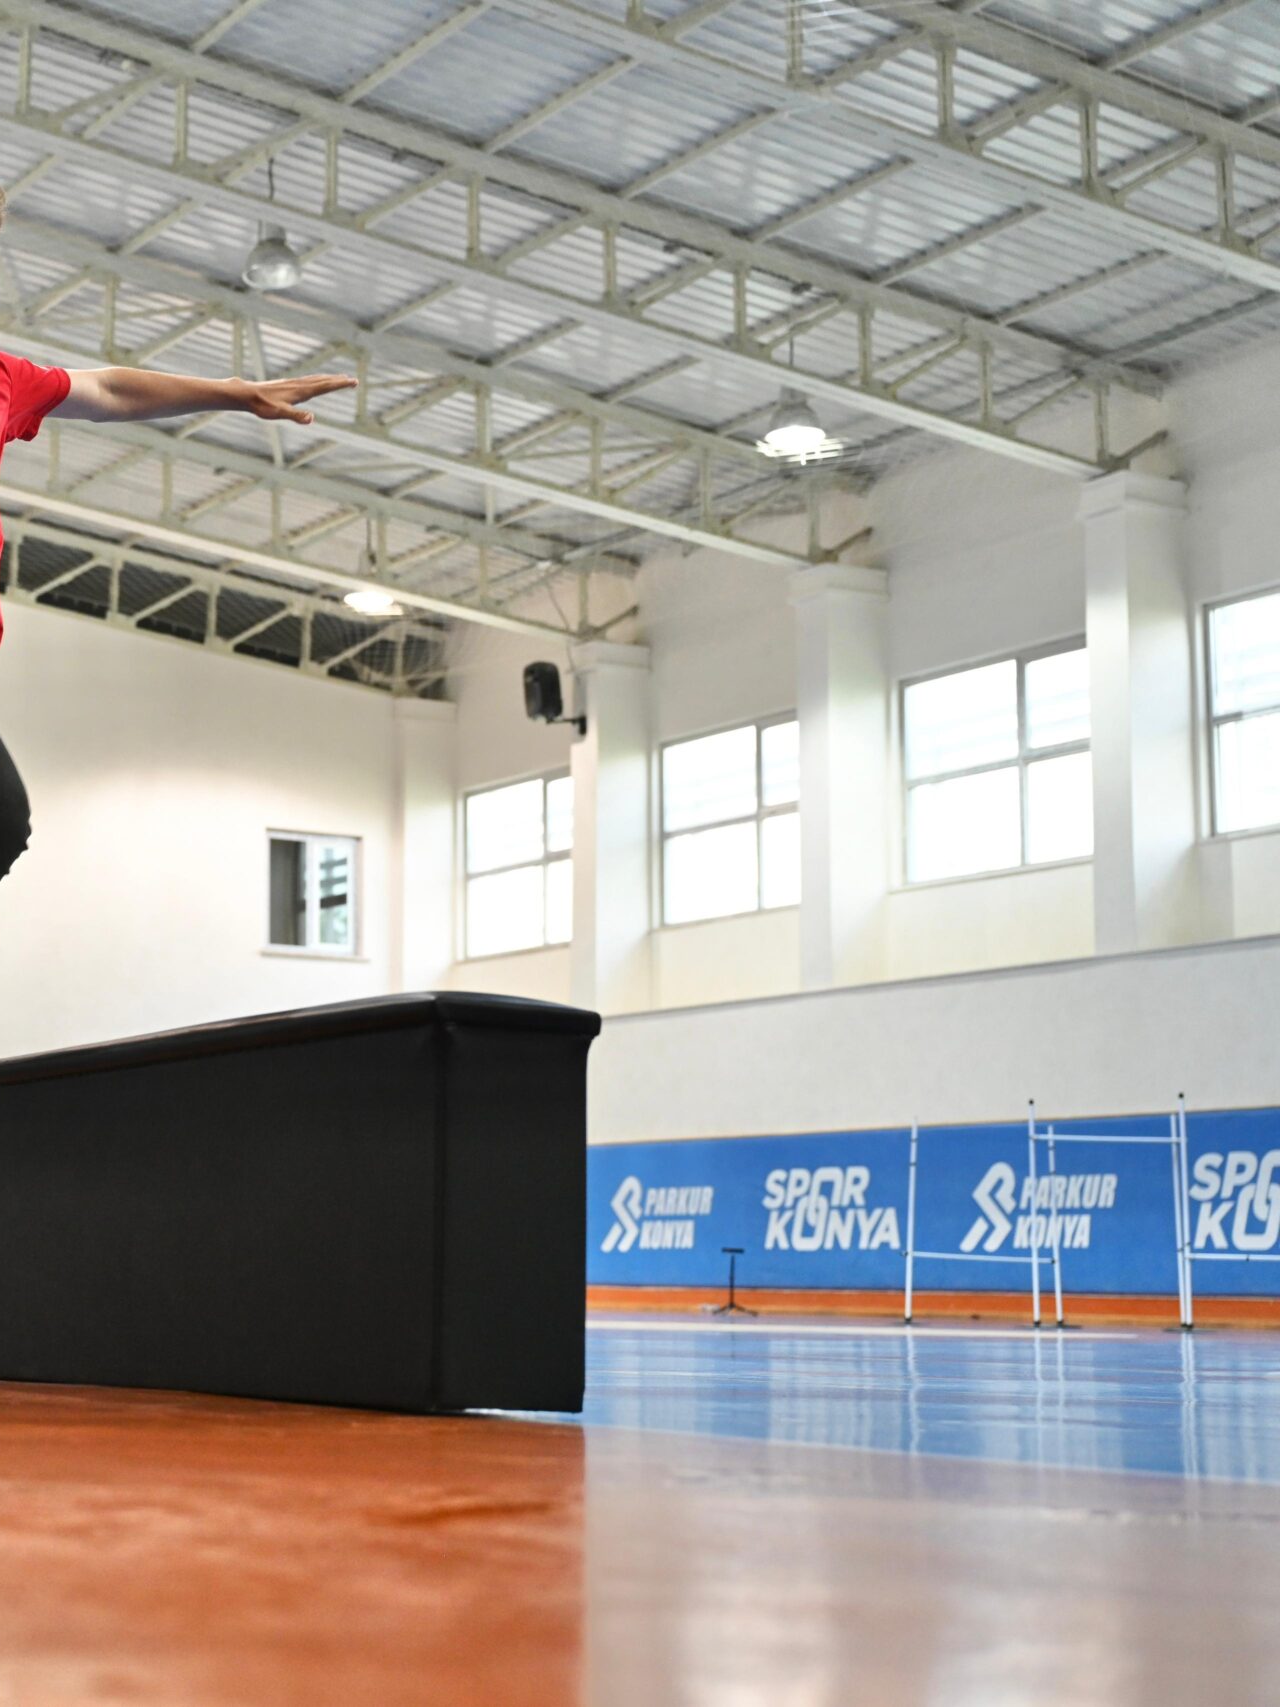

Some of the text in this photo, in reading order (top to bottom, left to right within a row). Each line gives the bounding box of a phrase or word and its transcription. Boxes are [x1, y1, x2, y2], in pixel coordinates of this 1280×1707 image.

[644, 1186, 714, 1216] PARKUR
[762, 1166, 870, 1216] SPOR
[1020, 1173, 1118, 1210] PARKUR
[639, 1219, 694, 1250] KONYA
[764, 1195, 900, 1252] KONYA
[1013, 1213, 1091, 1249] KONYA
